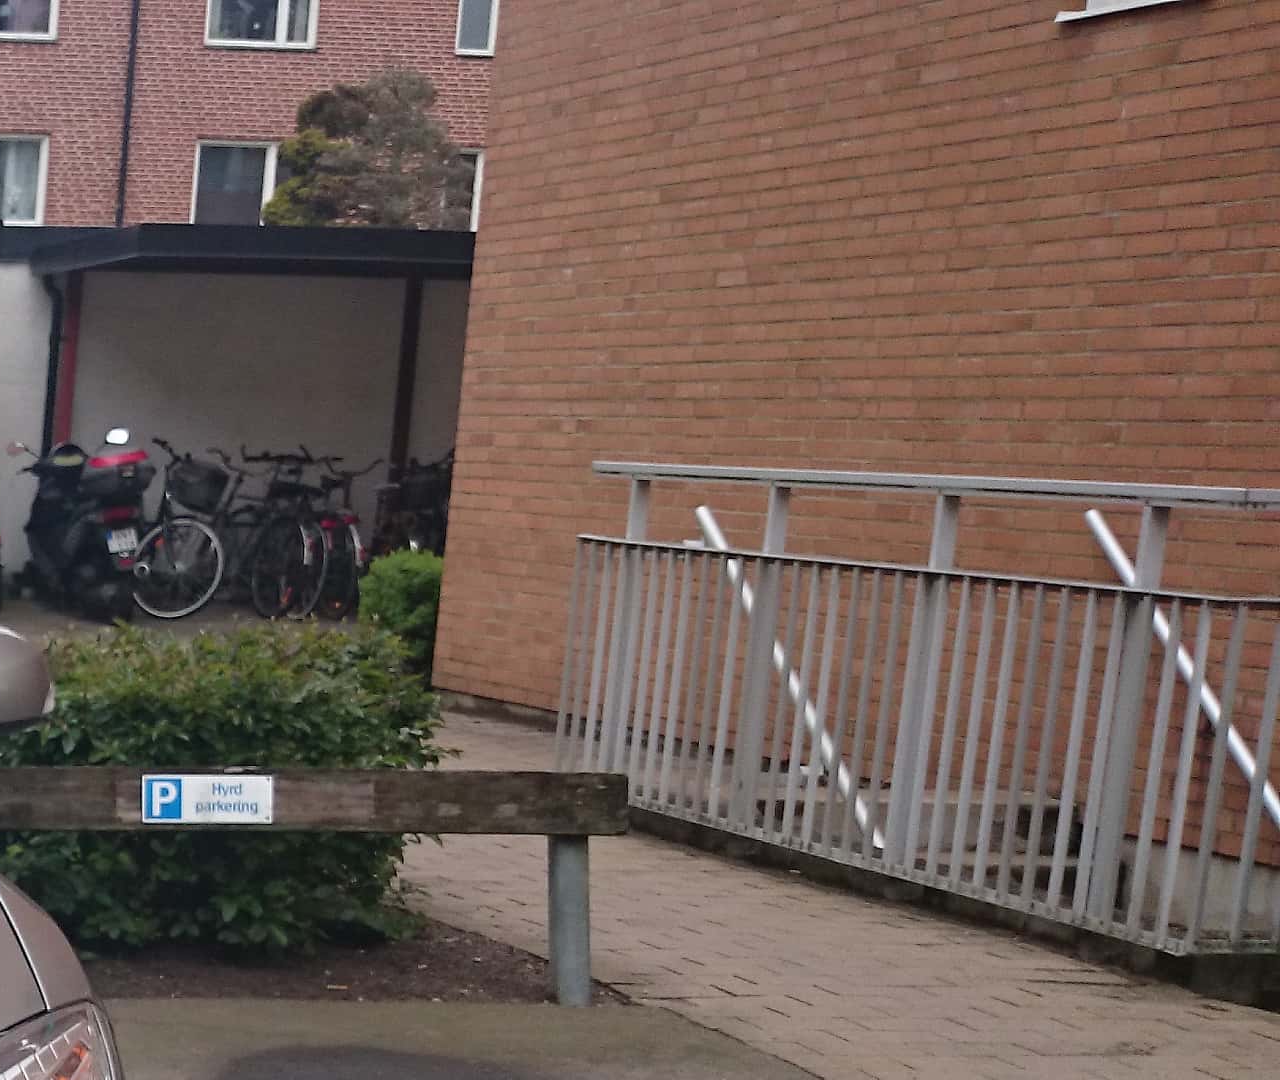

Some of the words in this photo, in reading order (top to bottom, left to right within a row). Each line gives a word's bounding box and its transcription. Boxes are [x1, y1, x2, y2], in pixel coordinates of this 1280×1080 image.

[211, 783, 243, 797] Hyrd
[151, 781, 177, 817] P
[195, 800, 258, 815] parkering
